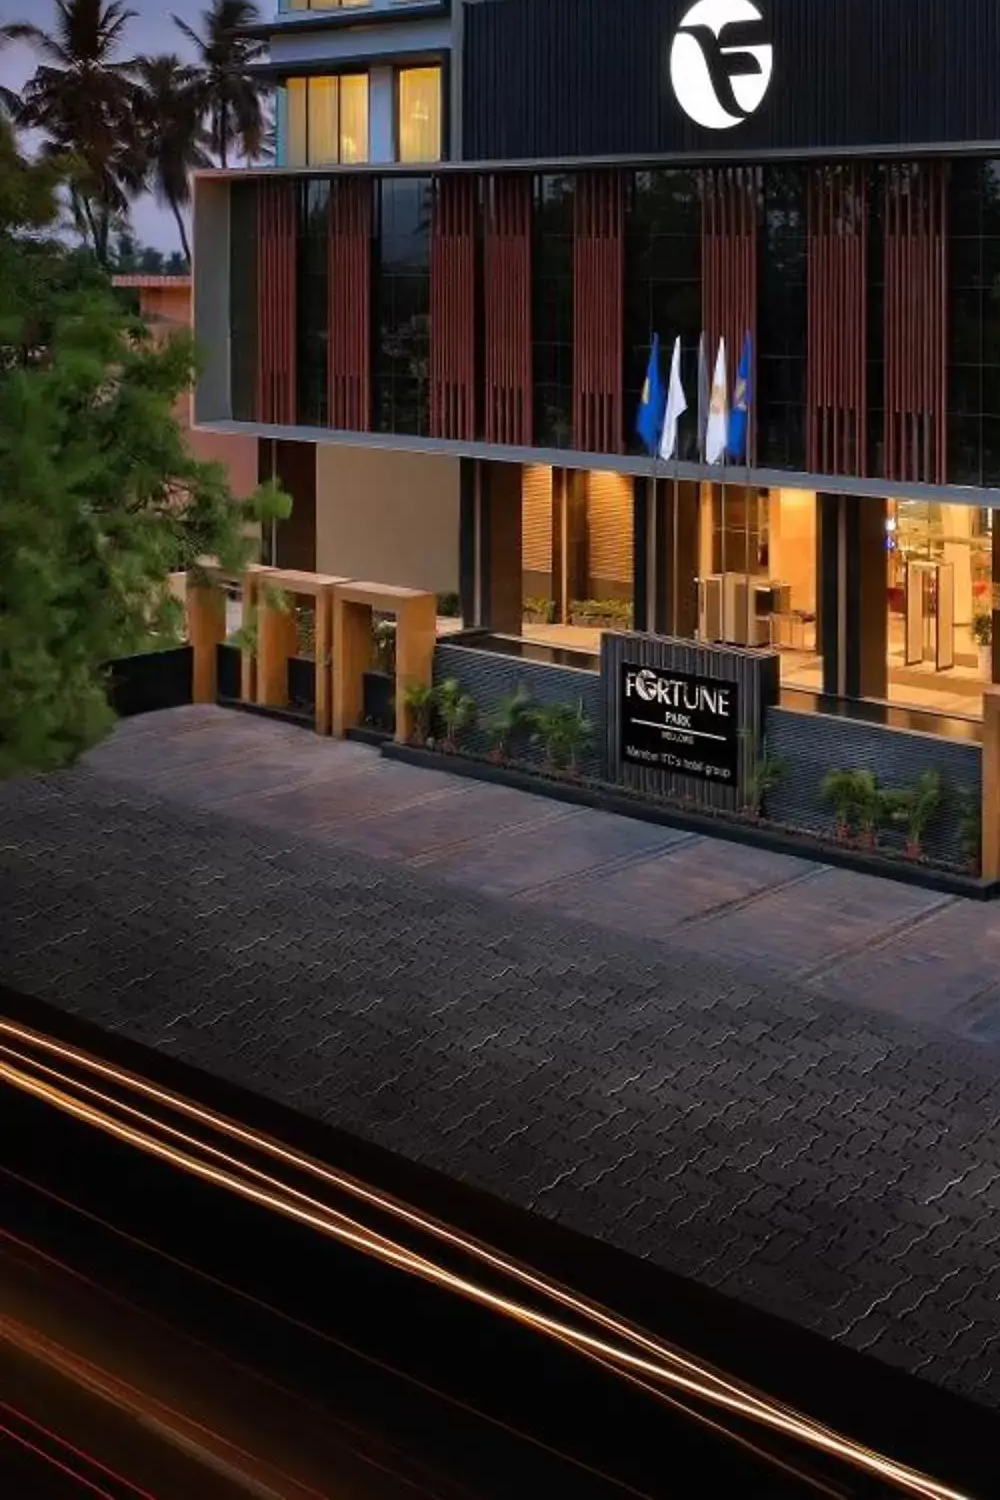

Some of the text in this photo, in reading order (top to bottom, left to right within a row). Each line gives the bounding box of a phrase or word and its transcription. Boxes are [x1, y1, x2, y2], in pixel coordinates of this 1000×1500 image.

[625, 669, 730, 716] FORTUNE
[665, 711, 691, 727] PARK
[705, 765, 731, 779] group
